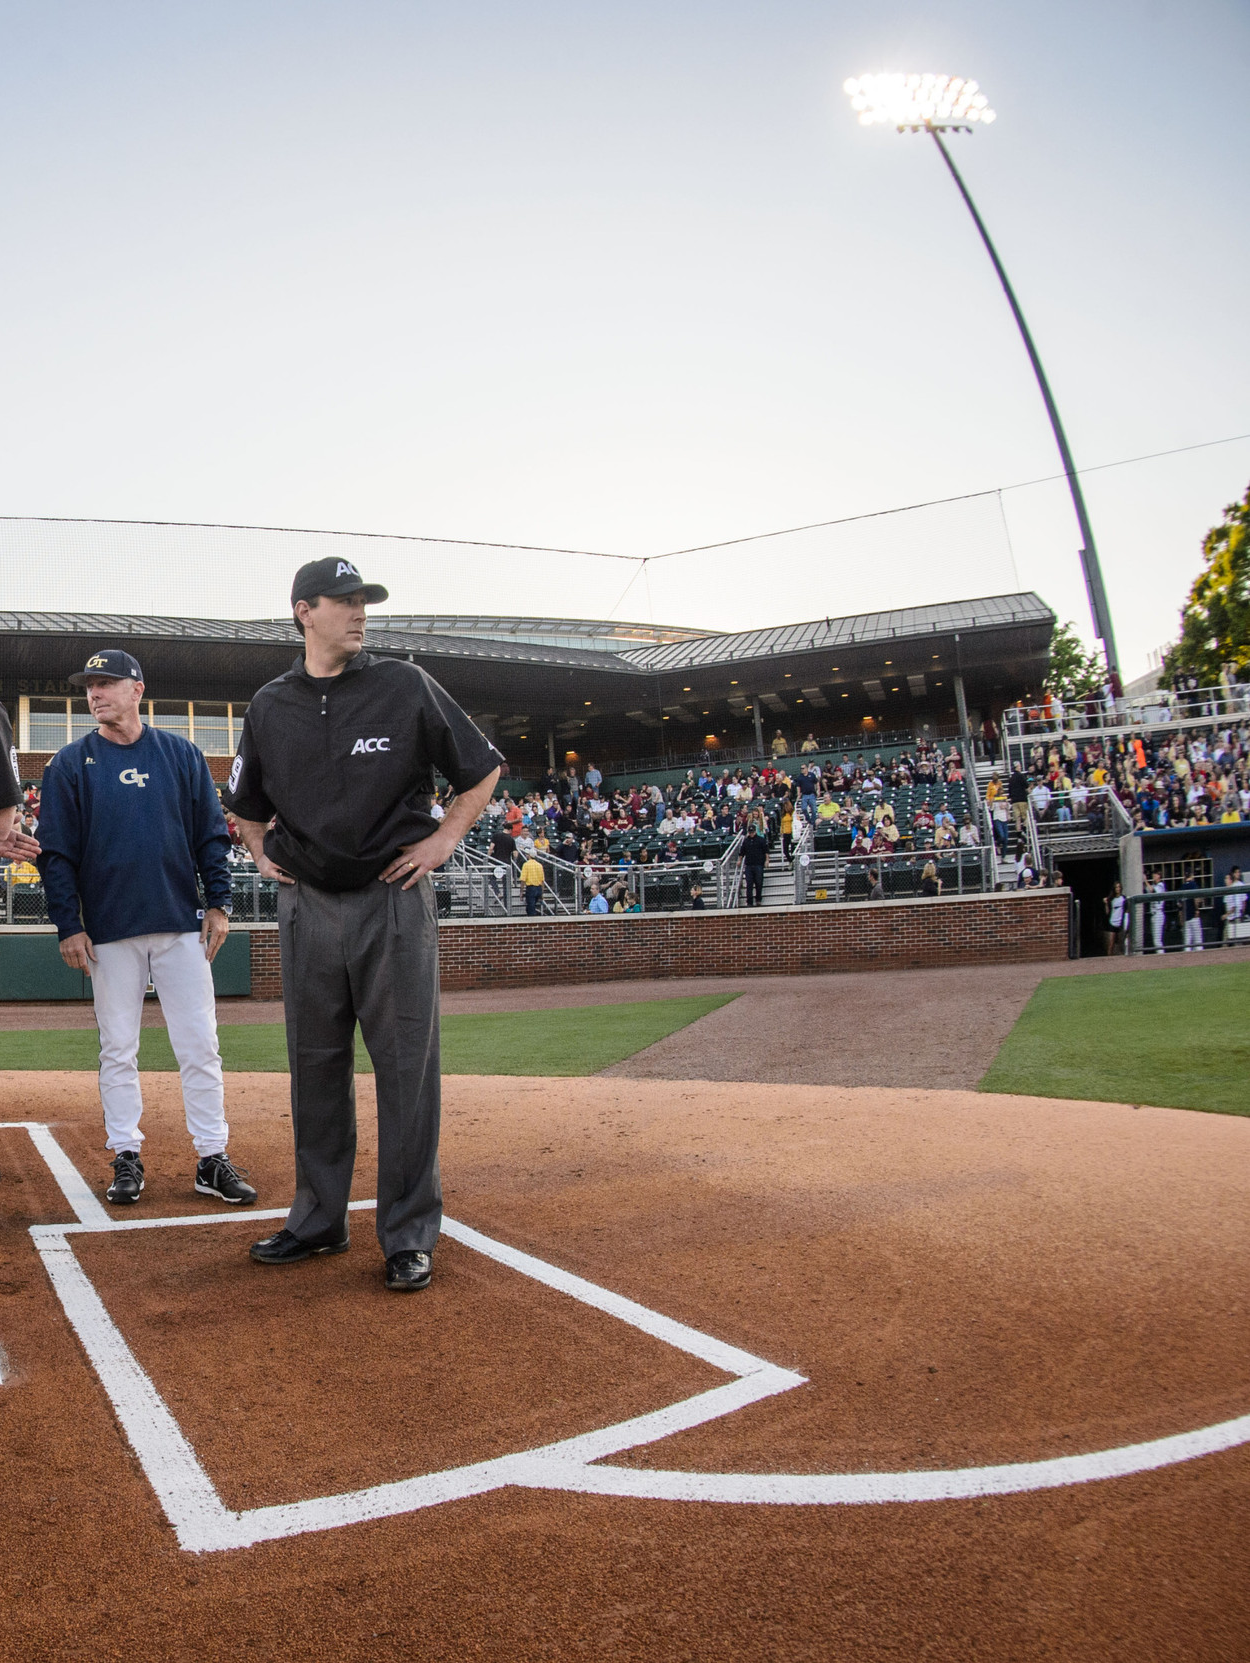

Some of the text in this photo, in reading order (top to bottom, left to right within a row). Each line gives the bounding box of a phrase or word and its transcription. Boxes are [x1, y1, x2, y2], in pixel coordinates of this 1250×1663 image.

[87, 655, 108, 668] GT
[351, 737, 390, 756] ACC
[119, 768, 149, 787] GT
